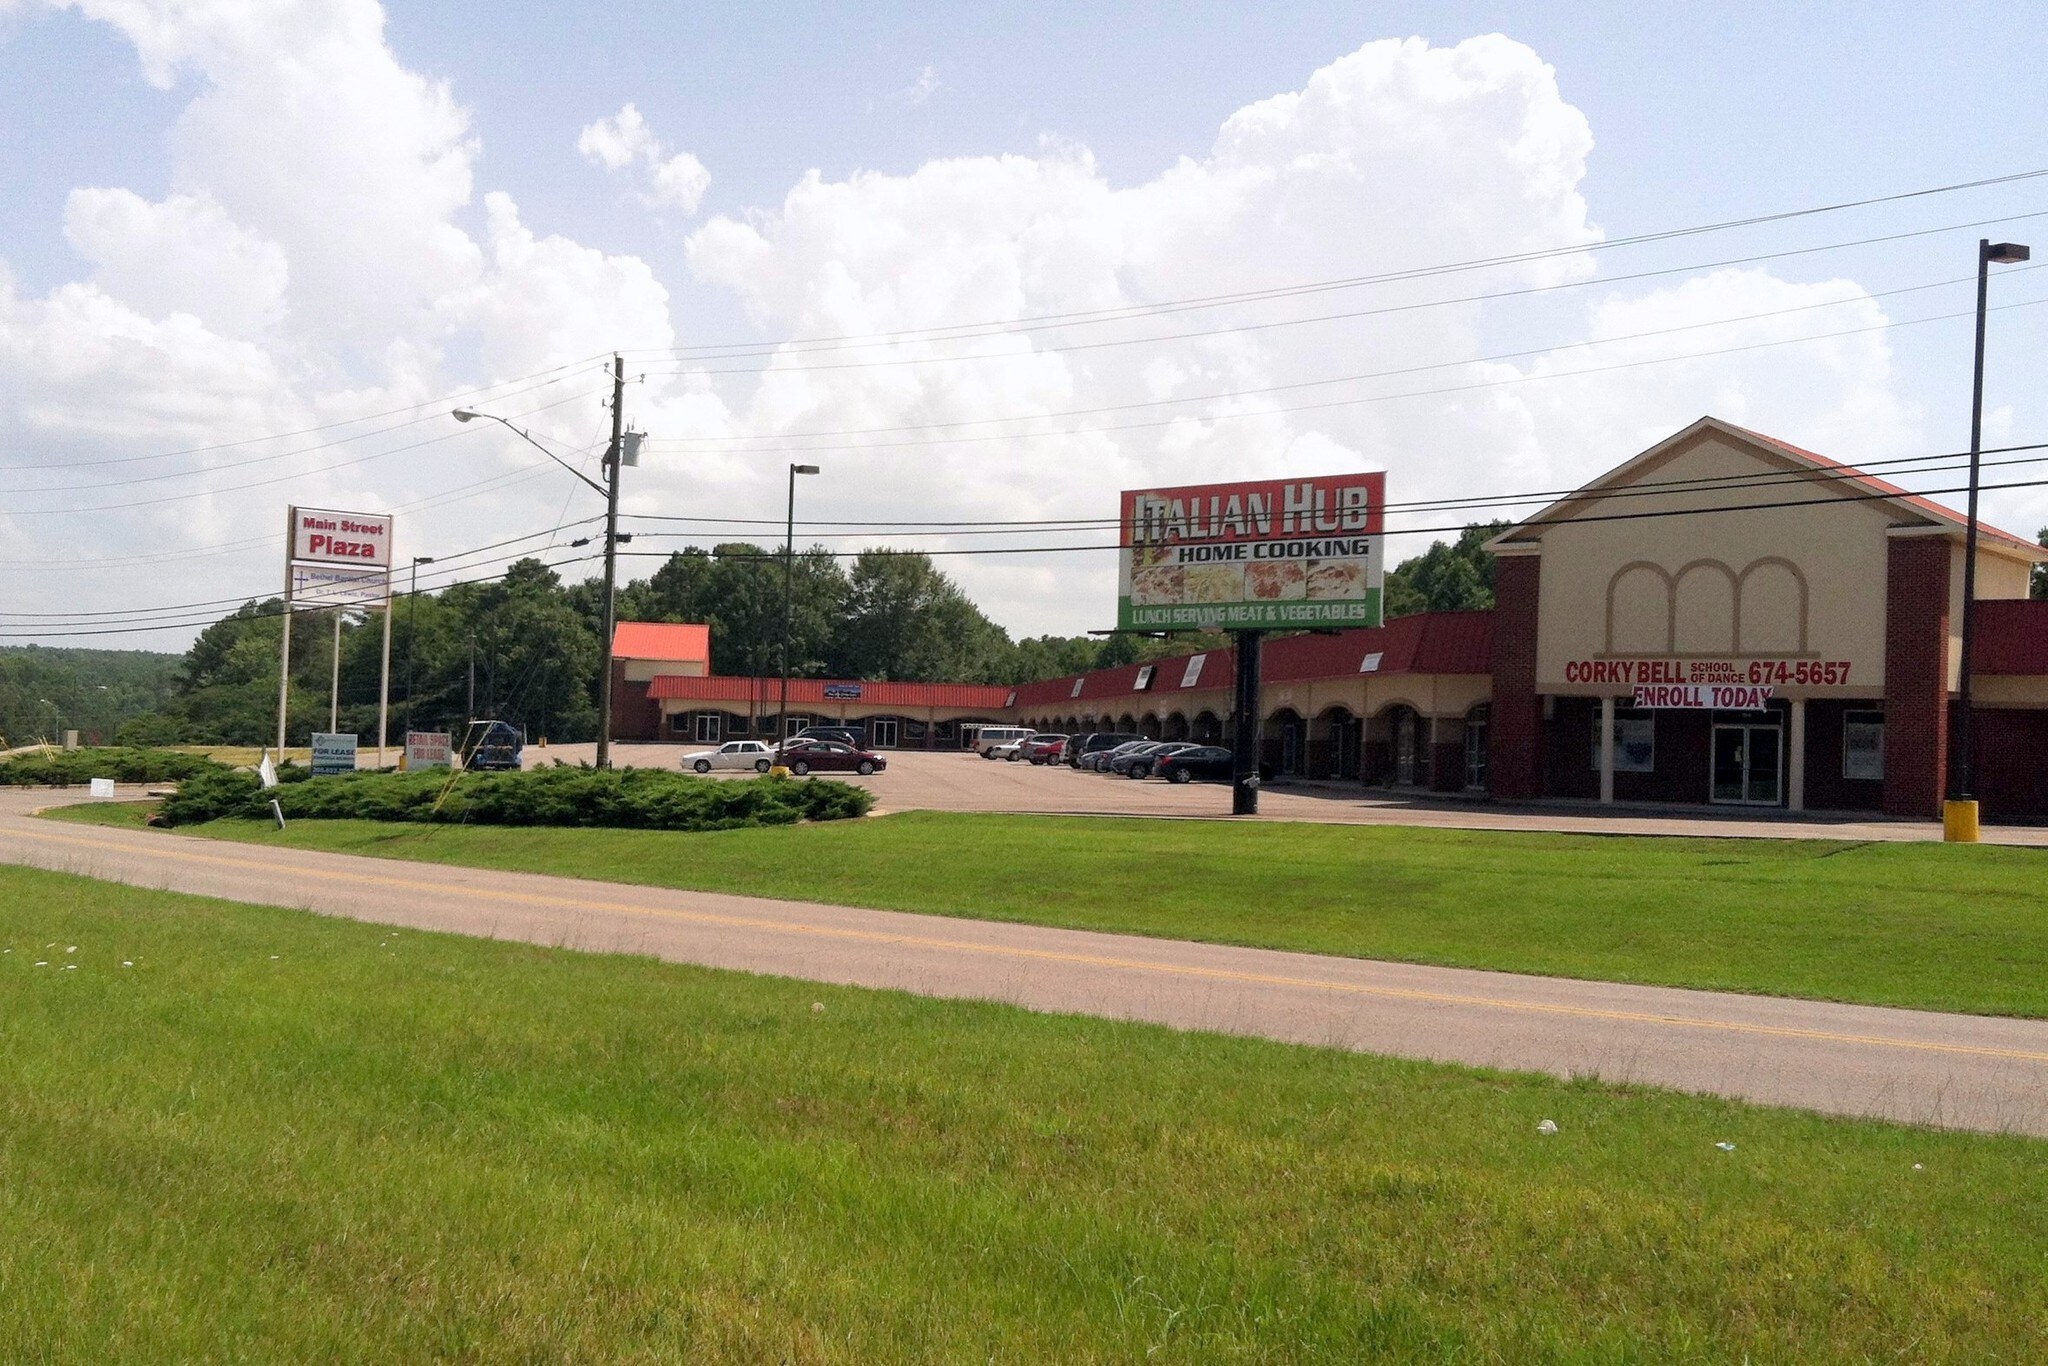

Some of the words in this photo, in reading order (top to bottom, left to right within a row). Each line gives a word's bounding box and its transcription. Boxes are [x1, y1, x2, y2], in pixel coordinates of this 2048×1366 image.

[1133, 492, 1272, 543] ITALIAN
[1282, 483, 1369, 533] HUB
[303, 517, 336, 530] Main
[341, 520, 383, 535] Street
[310, 534, 375, 558] Plaza
[1179, 544, 1247, 562] HOME
[1253, 539, 1369, 559] COOKING
[1132, 610, 1171, 625] LUNCH
[1174, 607, 1225, 624] SERVING
[1228, 605, 1264, 622] MEAT
[1266, 605, 1277, 620] &
[1280, 603, 1366, 620] VEGETABLES
[1566, 660, 1634, 683] CORKY
[1637, 661, 1686, 683] BELL
[1691, 662, 1735, 672] SCHOOL
[1691, 673, 1706, 683] OF
[1708, 673, 1745, 683] DANCE
[1748, 661, 1852, 685] 674-5657
[1632, 686, 1703, 708] ENROLL
[1711, 686, 1774, 708] TODAY
